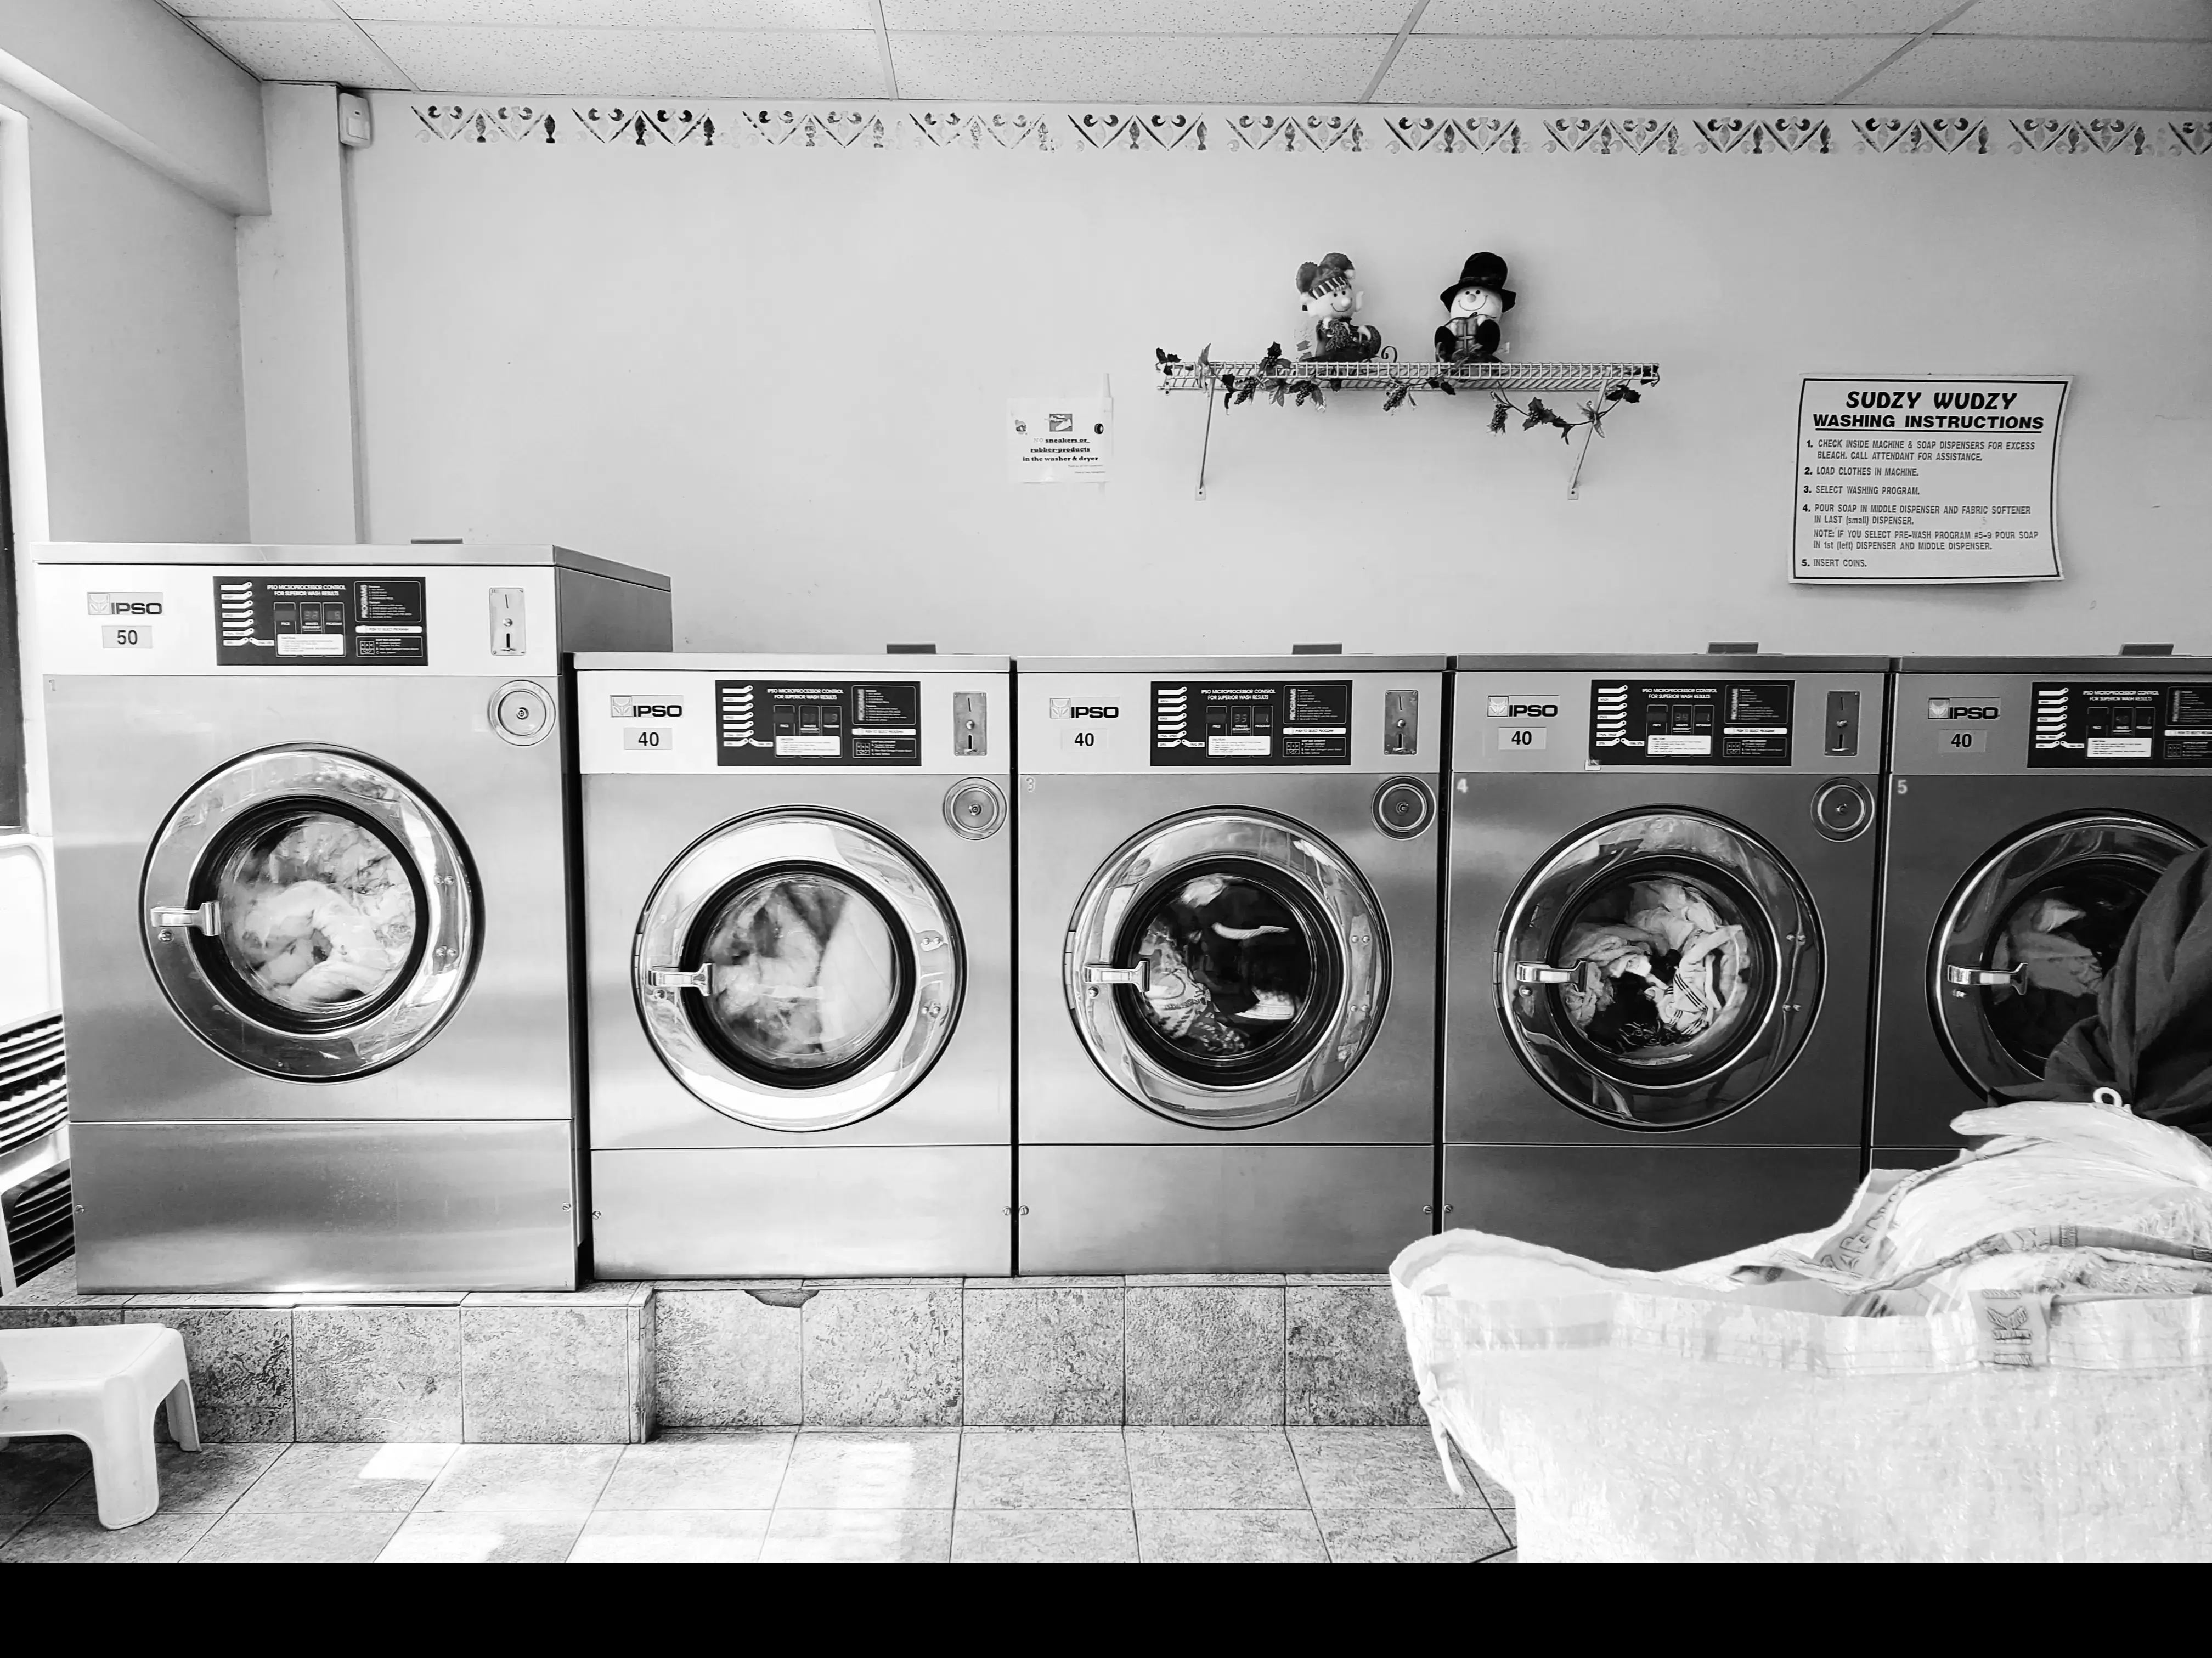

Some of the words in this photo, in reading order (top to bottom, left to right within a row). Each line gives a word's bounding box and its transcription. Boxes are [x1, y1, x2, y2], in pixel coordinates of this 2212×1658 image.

[1846, 391, 1922, 409] SUDZY
[1934, 392, 2017, 409] WUDZY
[1813, 414, 1895, 427] WASHING
[1905, 415, 2044, 428] INSTRUCTIONS
[1819, 439, 1842, 448] CHECK
[1917, 441, 1936, 449] SOAP
[1940, 441, 1984, 449] DISPENSERS
[2006, 442, 2035, 450] EXCESS
[1818, 451, 1847, 459] BLEACH.
[1872, 452, 1915, 460] ATTENDANT
[1918, 452, 1932, 460] FOR
[1936, 453, 1982, 461] ASSISTANCE.
[1839, 467, 1871, 475] CLOTHES
[1847, 486, 1878, 494] WASHING
[1882, 487, 1920, 495] PROGRAM.
[1871, 505, 1897, 513] MIDDLE
[1900, 505, 1939, 514] DISPENSER
[1825, 515, 1842, 523] LAST
[1846, 516, 1869, 526] (small)
[1872, 516, 1914, 525] DISPENSER.
[1837, 541, 1853, 550] (left)
[111, 602, 162, 615] IPSO
[117, 630, 138, 645] 50
[633, 705, 682, 717] IPSO
[1071, 707, 1119, 719] IPSO
[1509, 704, 1558, 717] IPSO
[1949, 707, 1999, 719] IPSO
[638, 732, 659, 746] 40
[1074, 732, 1094, 746] 40
[1511, 731, 1532, 745] 40
[1951, 733, 1972, 747] 40
[1457, 778, 1469, 793] 4
[1897, 779, 1908, 794] 5
